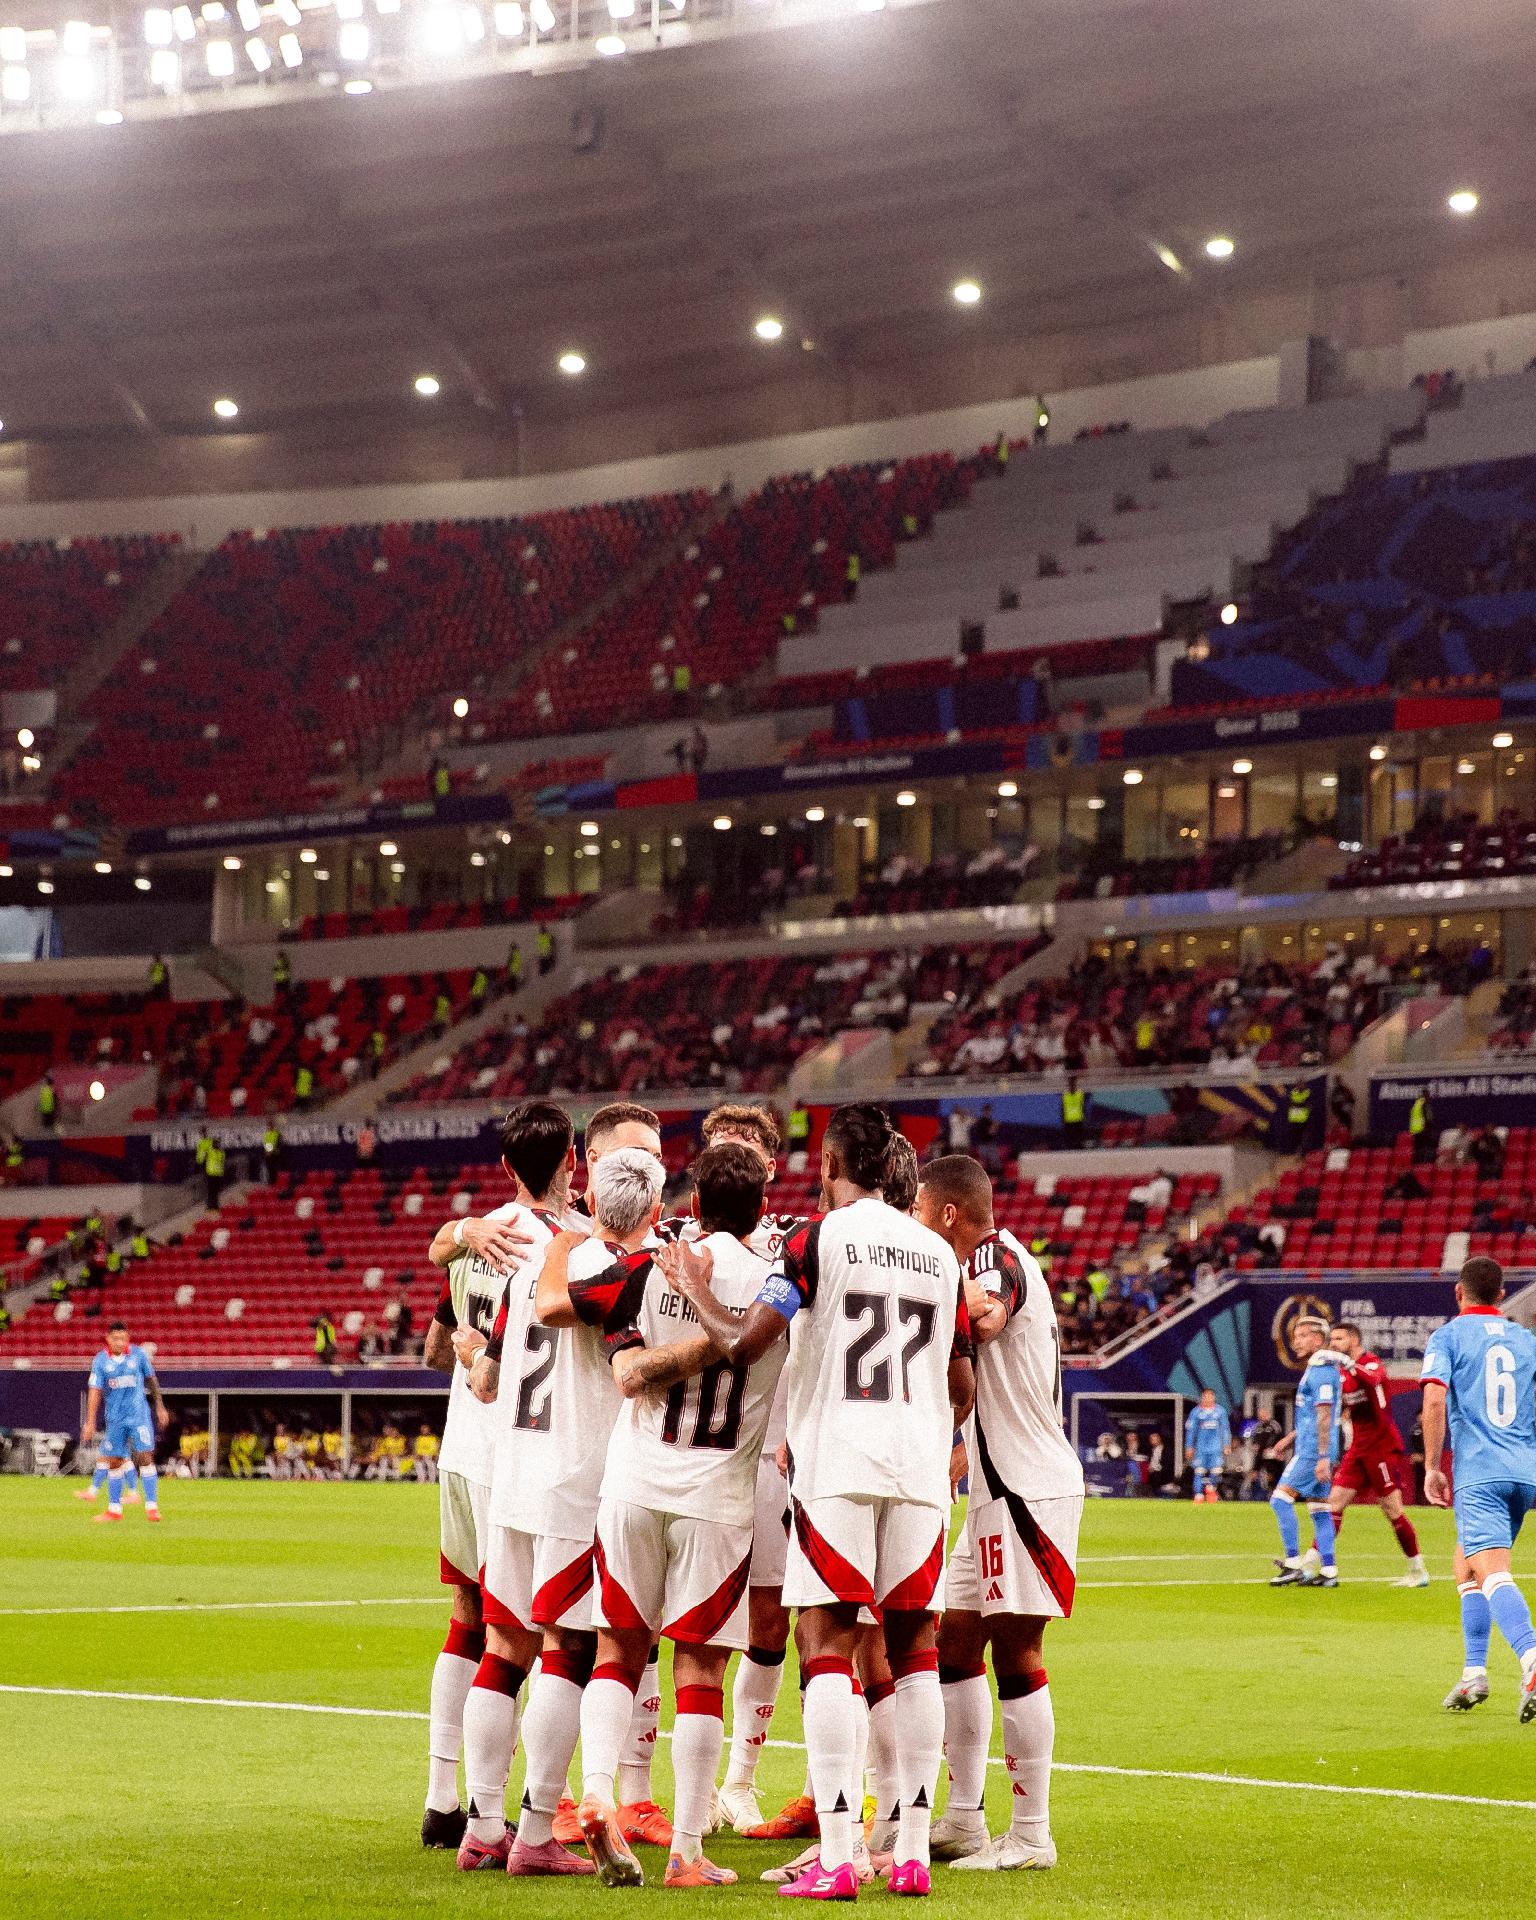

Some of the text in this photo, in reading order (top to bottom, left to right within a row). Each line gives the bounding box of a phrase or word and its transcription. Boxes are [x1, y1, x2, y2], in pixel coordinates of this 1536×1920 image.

[845, 1243, 941, 1278] B. HENRIQUE
[659, 1292, 680, 1319] DE
[1341, 1299, 1376, 1316] FIFA
[841, 1289, 940, 1404] 27
[512, 1322, 560, 1433] 2
[1484, 1345, 1518, 1429] 6
[660, 1356, 752, 1451] 10
[1377, 1461, 1394, 1488] 1
[978, 1534, 1004, 1580] 16
